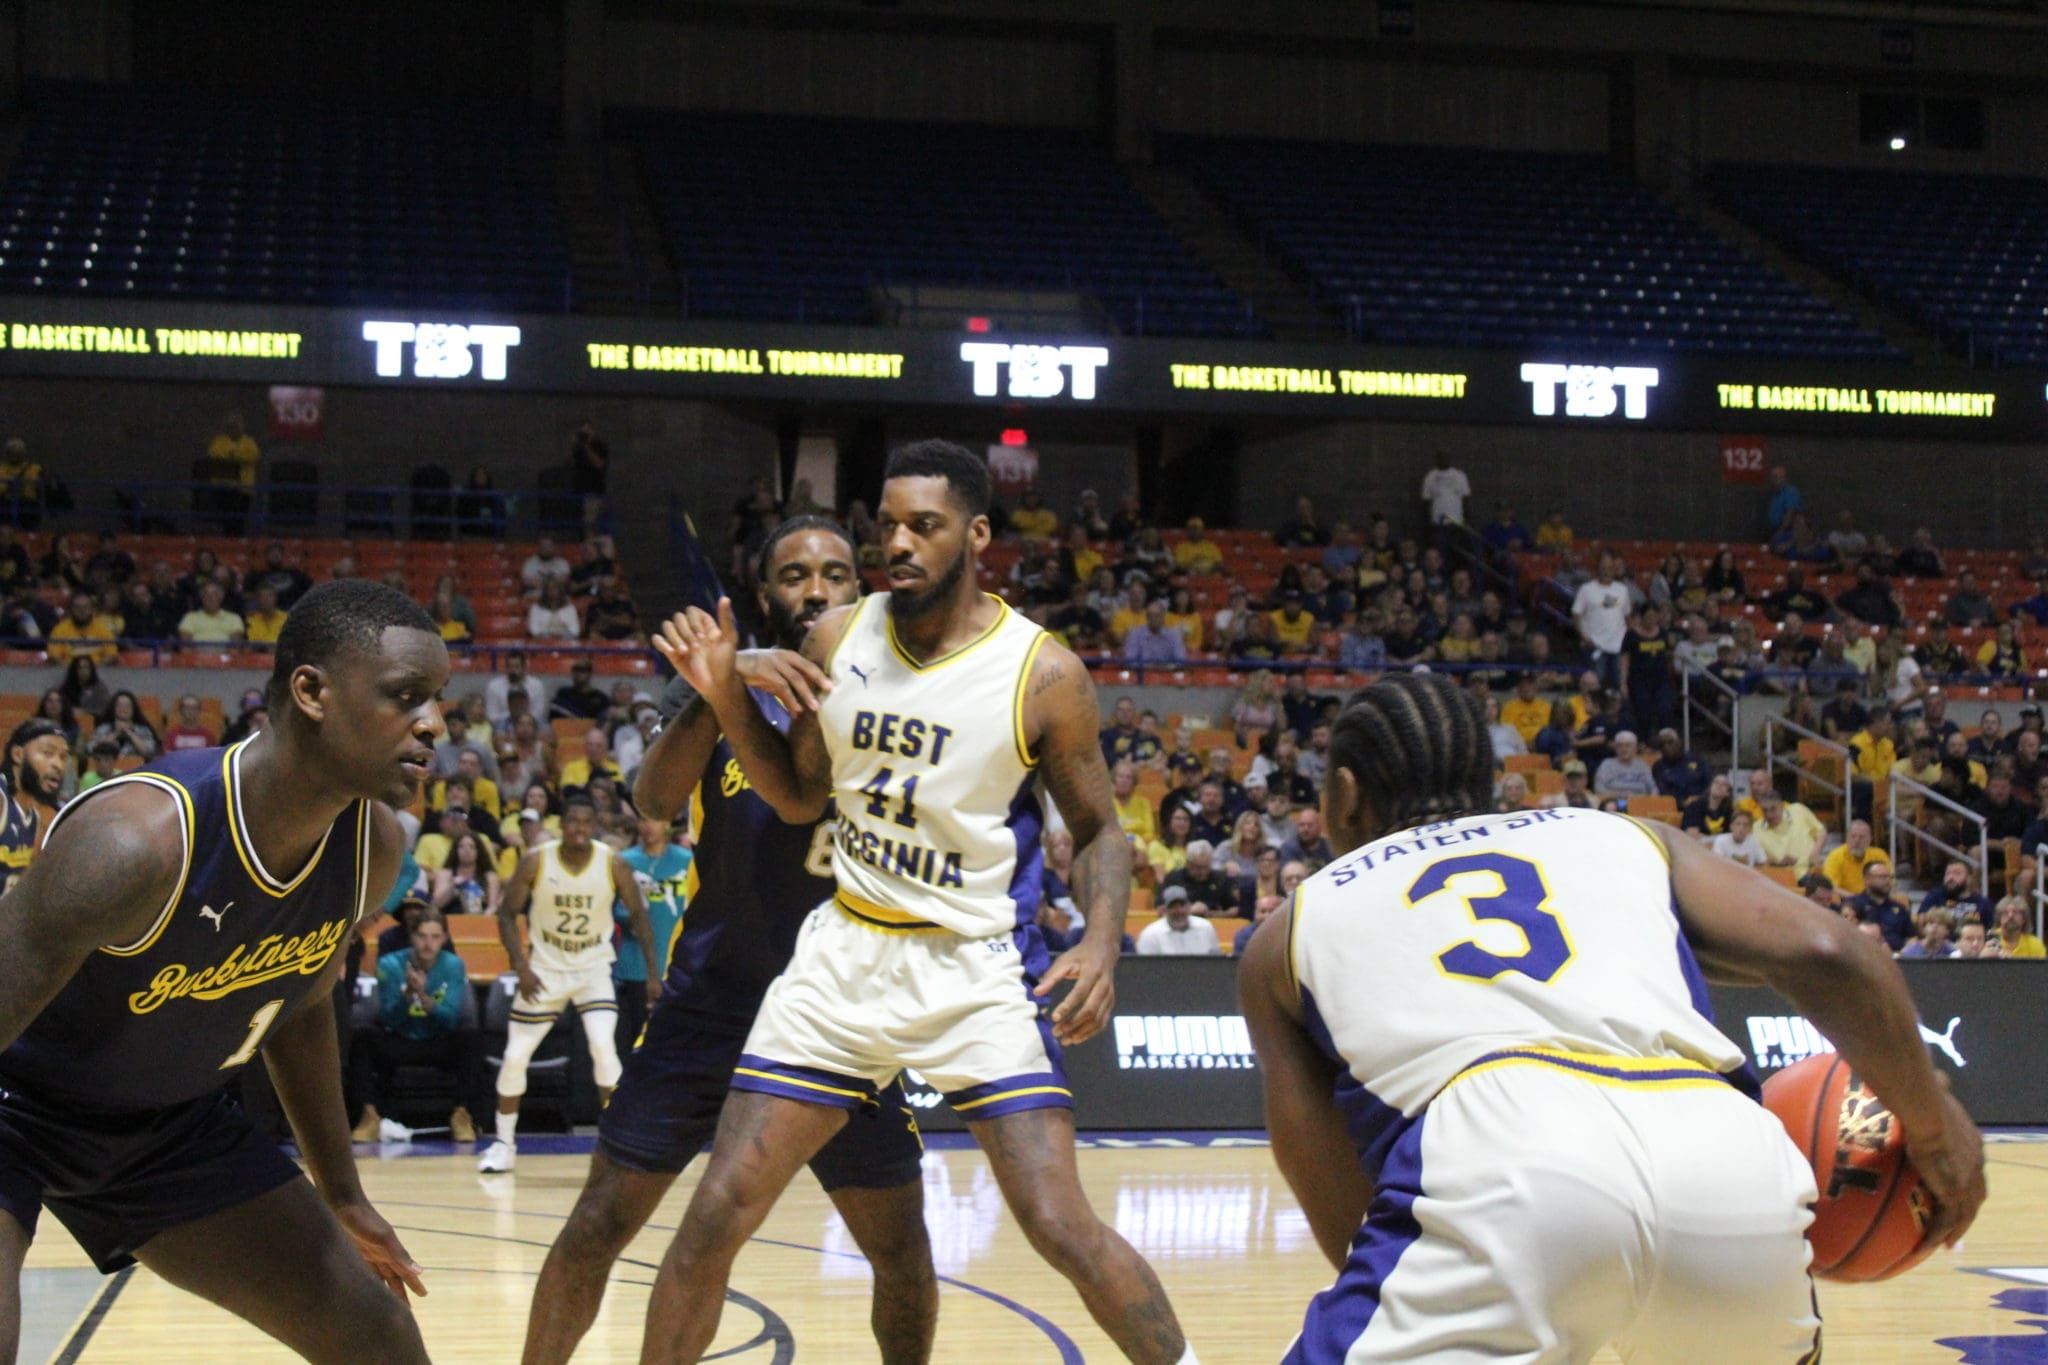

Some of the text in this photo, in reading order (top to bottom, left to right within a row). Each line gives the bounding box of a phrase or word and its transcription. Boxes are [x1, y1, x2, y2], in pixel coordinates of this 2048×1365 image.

[11, 324, 151, 353] BASKETBALL
[155, 328, 302, 358] TOURNAMENT
[363, 320, 521, 380] TBT
[587, 343, 903, 378] THE BASKETBALL TOURNAMENT
[960, 342, 1109, 400] TBT
[1170, 364, 1467, 398] THE BASKETBALL TOURNAMENT
[1520, 362, 1660, 420] TBT
[276, 401, 320, 426] 130
[1717, 384, 1996, 417] THE BASKETBALL TOURNAMENT
[1724, 448, 1764, 471] 132
[852, 709, 954, 767] BEST
[857, 766, 922, 830] 41
[1330, 826, 1491, 888] STATEN
[554, 893, 594, 909] BEST
[1402, 849, 1577, 985] 3
[555, 910, 591, 936] 22
[217, 999, 285, 1071] 1
[1113, 1015, 1256, 1056] PUMA
[1118, 1054, 1256, 1069] BASKETBALL
